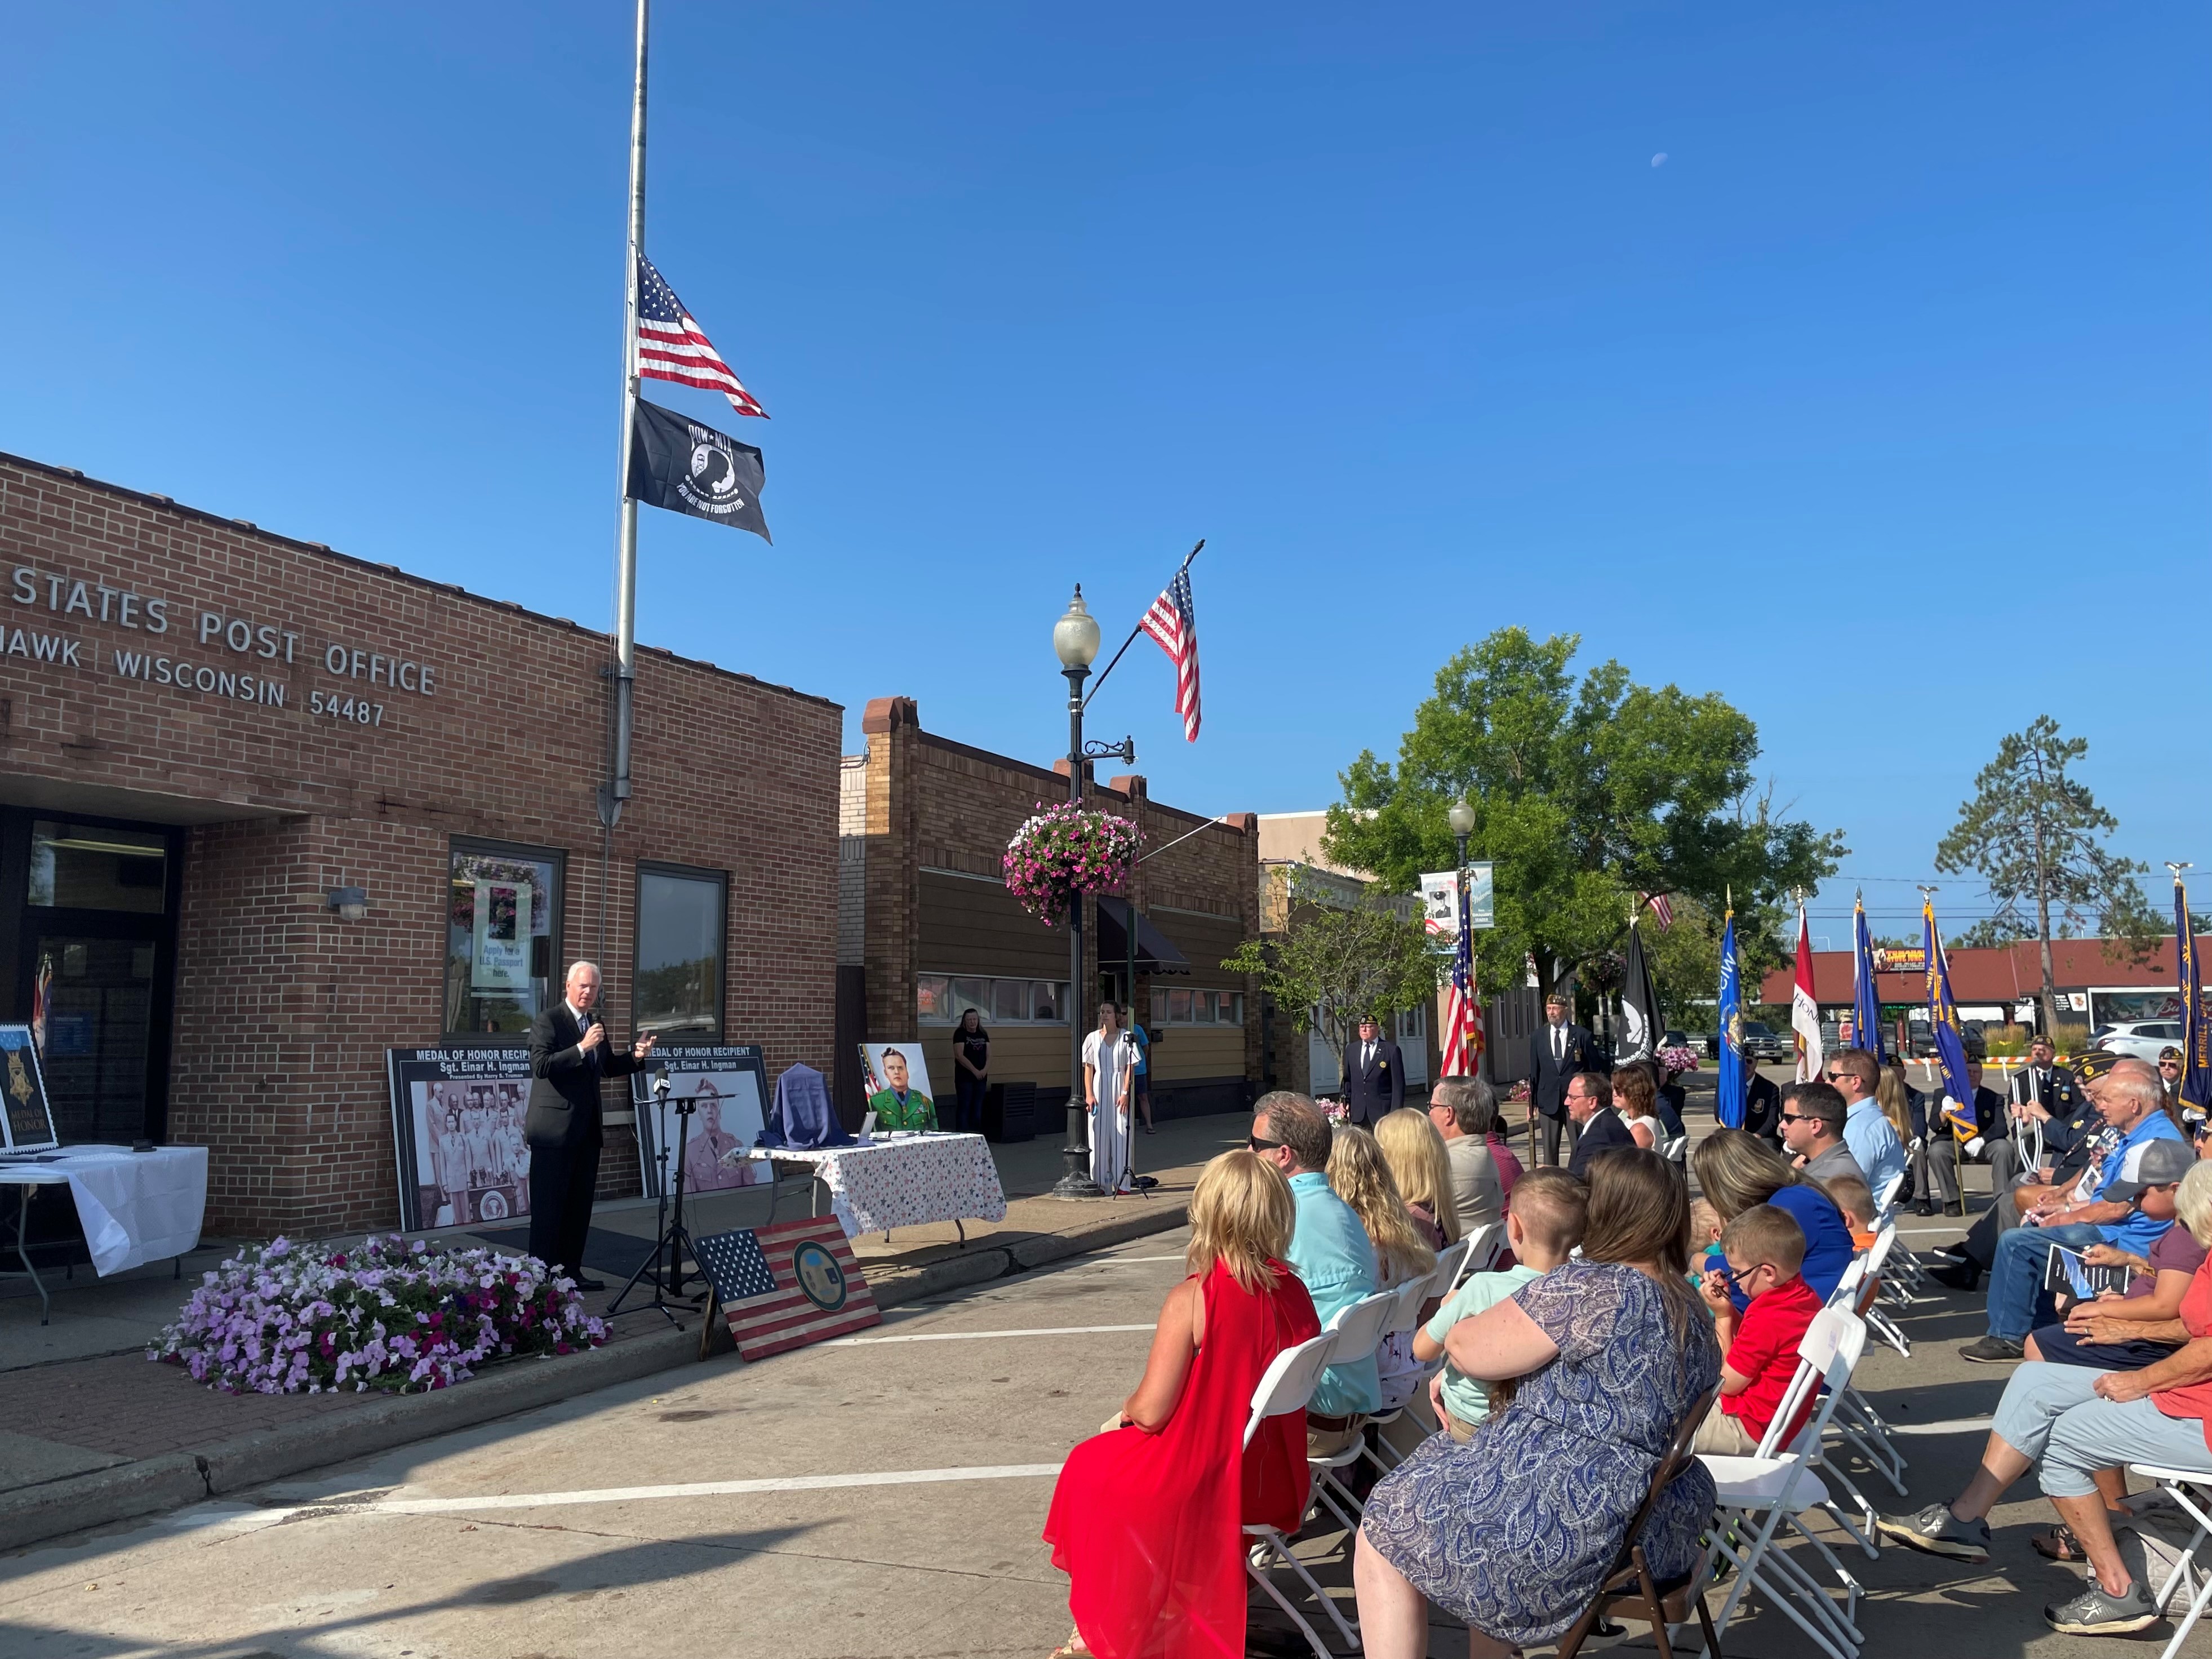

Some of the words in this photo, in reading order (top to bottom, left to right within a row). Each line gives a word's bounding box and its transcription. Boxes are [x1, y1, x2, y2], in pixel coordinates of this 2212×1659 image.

[688, 425, 708, 451] POW
[715, 432, 734, 467] MIA
[677, 482, 687, 497] YOU
[685, 494, 698, 507] ARE
[696, 499, 710, 512] NOT
[710, 498, 745, 514] FORGOTTEN
[12, 567, 168, 633] STATES
[199, 612, 298, 664] POST
[325, 645, 435, 696] OFFICE
[116, 649, 284, 708] WISCONSIN
[310, 690, 384, 727] 54487
[484, 945, 503, 956] Apply
[505, 946, 513, 955] for
[479, 956, 492, 965] U.S.
[494, 957, 523, 968] Passport
[493, 969, 509, 978] here.
[673, 1047, 683, 1057] OF
[685, 1047, 712, 1057] HONOR
[714, 1046, 750, 1056] RECIPIENT
[2198, 1023, 2209, 1068] MERRILL
[416, 1050, 450, 1061] MEDAL
[452, 1050, 464, 1060] OF
[467, 1049, 500, 1060] HONOR
[440, 1062, 459, 1075] Sgt.
[461, 1061, 485, 1071] Einar
[487, 1061, 496, 1071] H.
[499, 1061, 530, 1073] Ingman
[664, 1061, 679, 1073] Sgt.
[681, 1060, 699, 1070] Einar
[701, 1060, 709, 1070] H.
[711, 1059, 736, 1071] Ingman
[11, 1108, 34, 1120] MEDAL
[13, 1119, 46, 1132] HONOR
